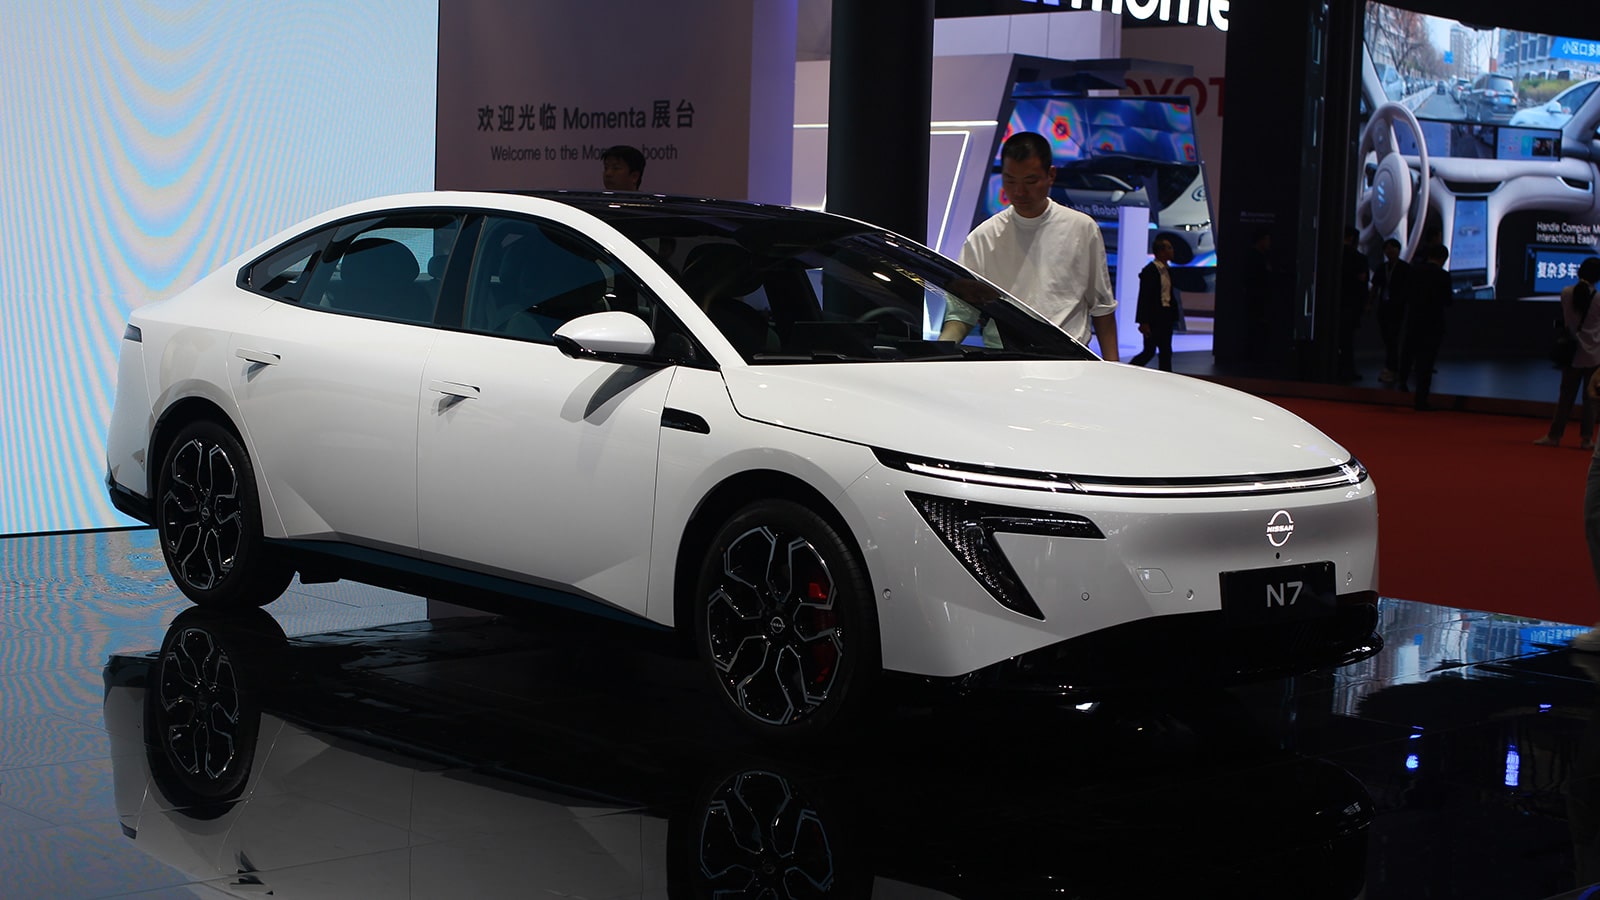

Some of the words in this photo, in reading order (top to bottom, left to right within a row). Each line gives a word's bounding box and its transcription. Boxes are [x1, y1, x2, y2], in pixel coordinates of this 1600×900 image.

[477, 103, 557, 132] 欢迎光临
[563, 107, 646, 129] Momenta
[652, 99, 695, 129] 展台
[491, 146, 541, 161] Welcome
[545, 147, 556, 161] to
[560, 145, 578, 161] the
[642, 144, 678, 160] booth
[1537, 221, 1560, 232] Handle
[1561, 222, 1591, 234] Complex
[1536, 233, 1576, 244] Interactions
[1577, 234, 1598, 246] Easily
[1537, 262, 1580, 279] 复杂多车
[1266, 525, 1294, 533] NISSAN
[1266, 581, 1304, 608] N7
